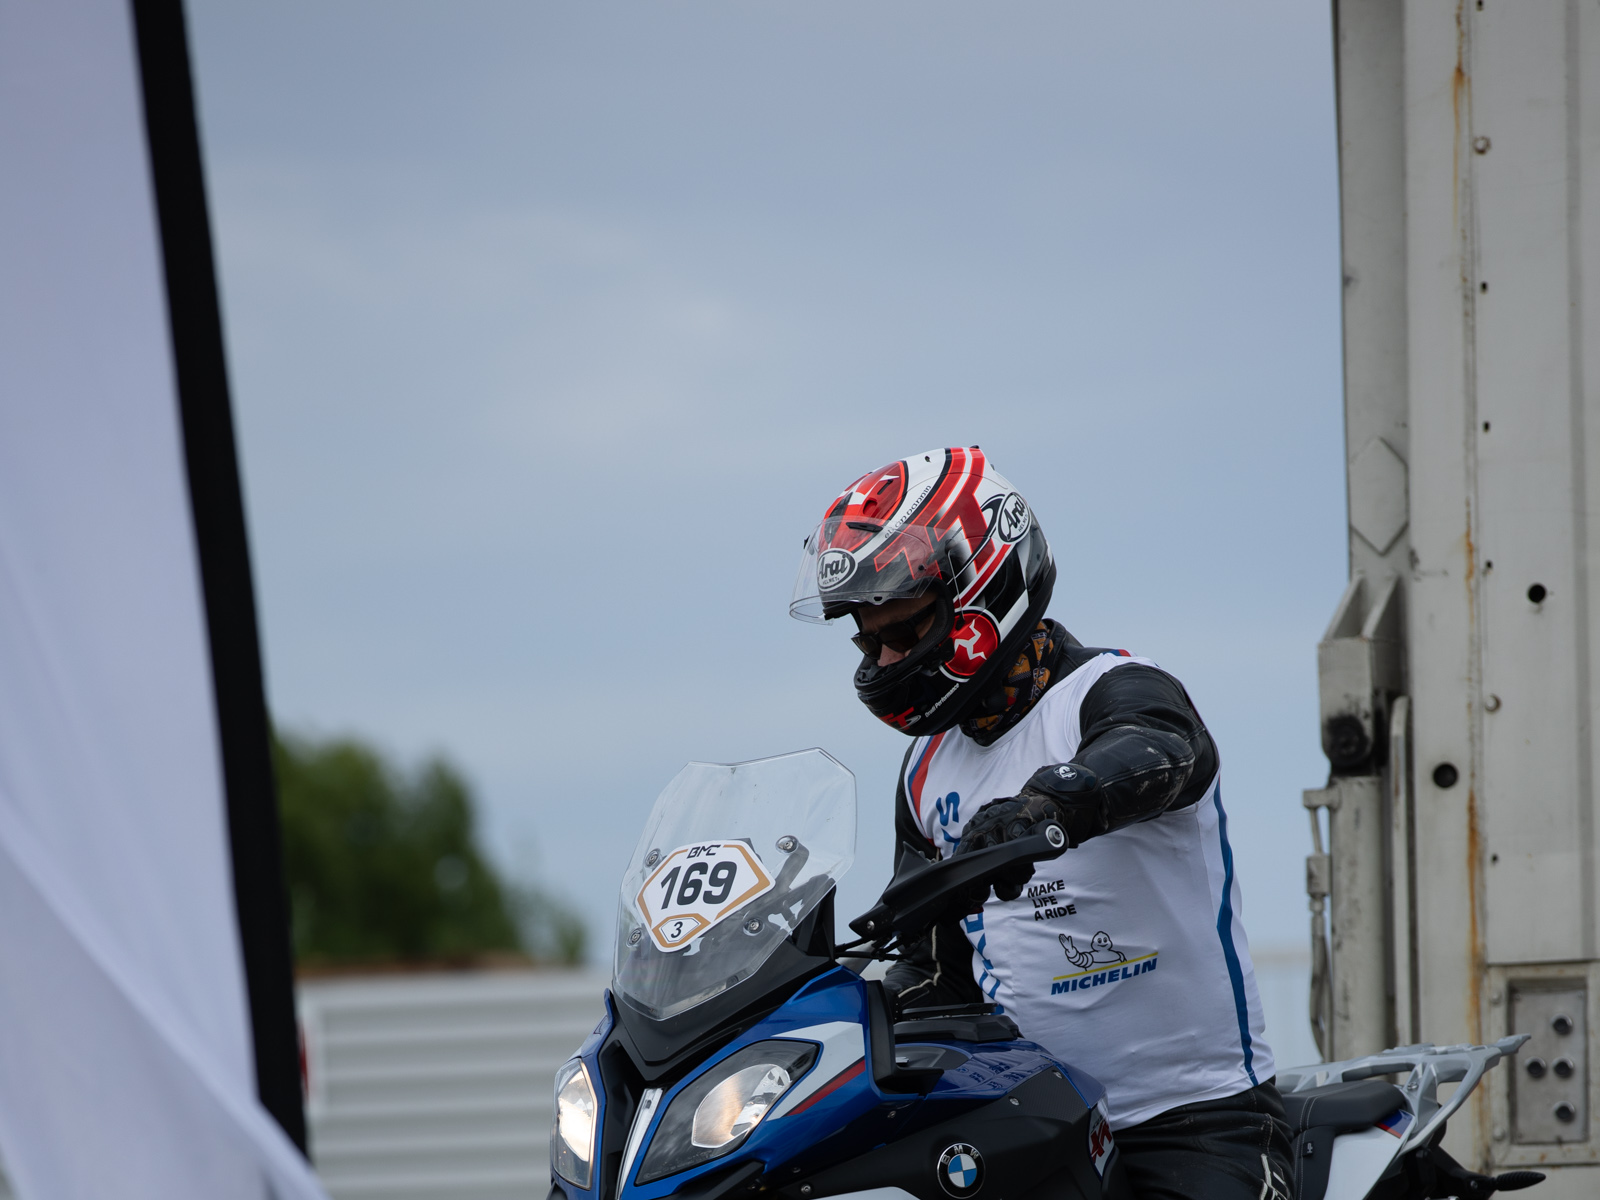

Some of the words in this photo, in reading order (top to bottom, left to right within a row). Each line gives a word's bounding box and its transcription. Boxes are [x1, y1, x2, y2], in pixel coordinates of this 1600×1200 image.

[1004, 494, 1026, 541] Arai
[818, 553, 849, 580] Arai
[660, 861, 738, 910] 169
[1027, 879, 1066, 899] MAKE
[1033, 895, 1059, 909] LIFE
[1034, 910, 1044, 922] A
[1044, 904, 1078, 921] RIDE
[669, 921, 684, 939] 3
[1050, 957, 1159, 996] MICHELIN
[940, 1144, 981, 1166] BMW
